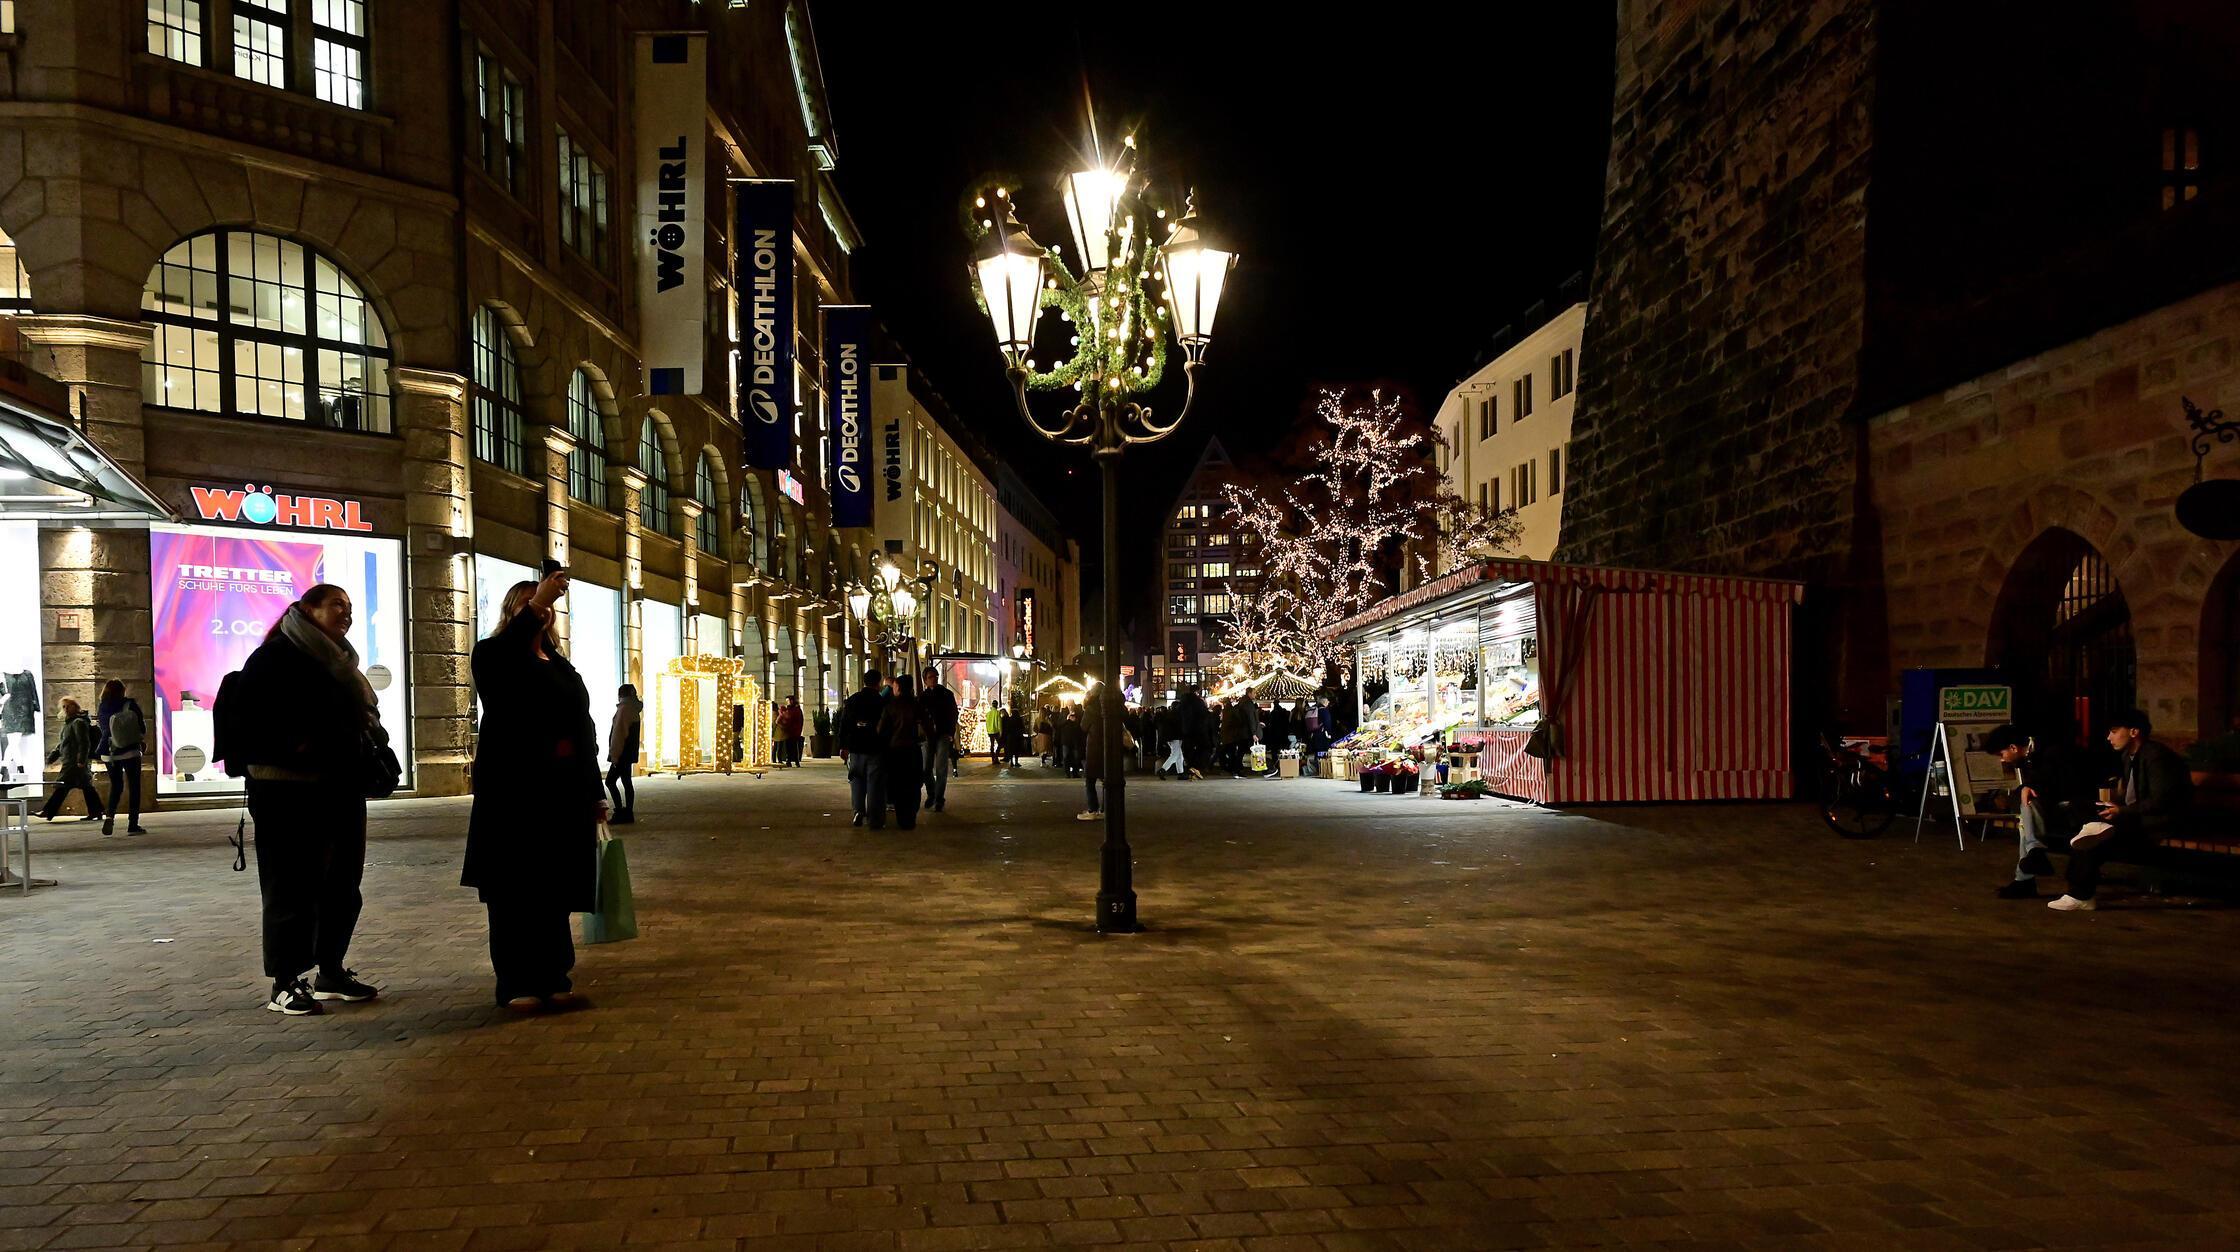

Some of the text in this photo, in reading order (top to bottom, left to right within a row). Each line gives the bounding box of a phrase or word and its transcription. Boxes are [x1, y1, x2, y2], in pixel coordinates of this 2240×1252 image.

[650, 136, 687, 294] WÖHRL
[754, 229, 776, 385] DECATHLON
[840, 343, 858, 463] DECATHLON
[883, 418, 901, 502] WÖHRL
[190, 483, 373, 532] WÖHRL
[178, 564, 293, 584] TRETTER
[178, 580, 294, 597] SCHUHE FÜRS LEBEN
[1963, 691, 2006, 708] DAV
